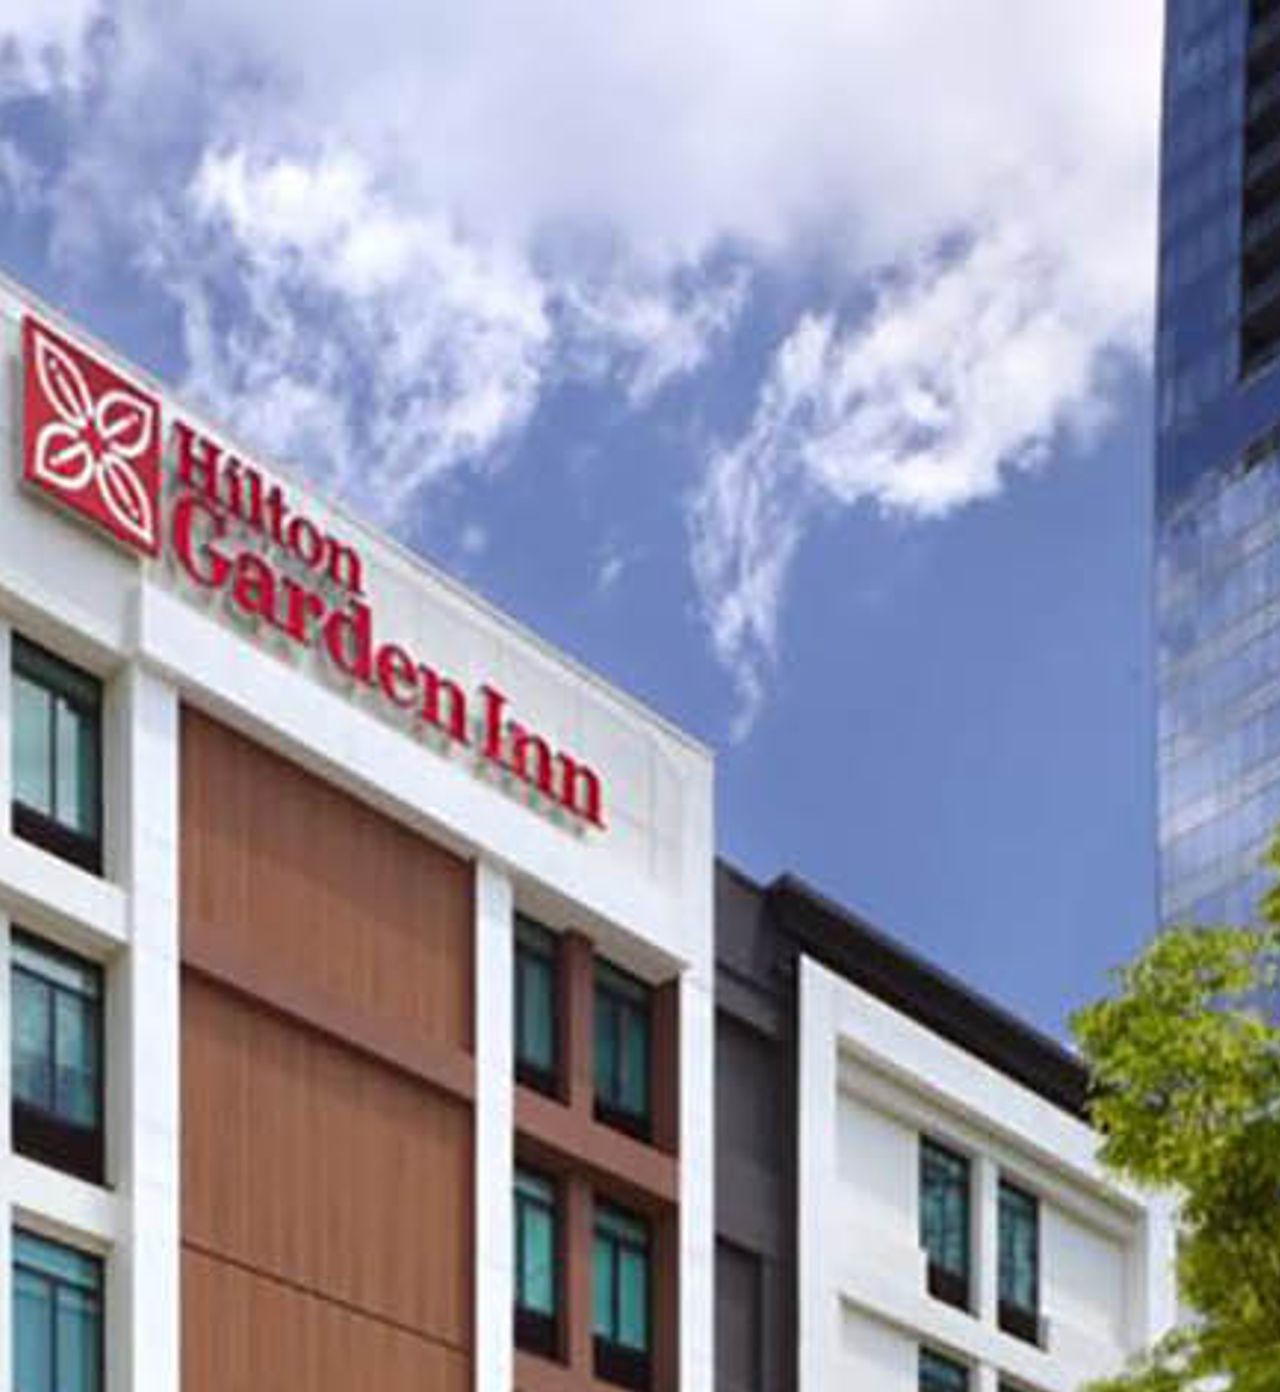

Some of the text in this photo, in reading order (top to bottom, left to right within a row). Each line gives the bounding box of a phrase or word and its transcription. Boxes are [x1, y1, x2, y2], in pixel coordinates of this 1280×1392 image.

[171, 419, 365, 597] Hilton
[171, 489, 607, 832] Garden Inn
